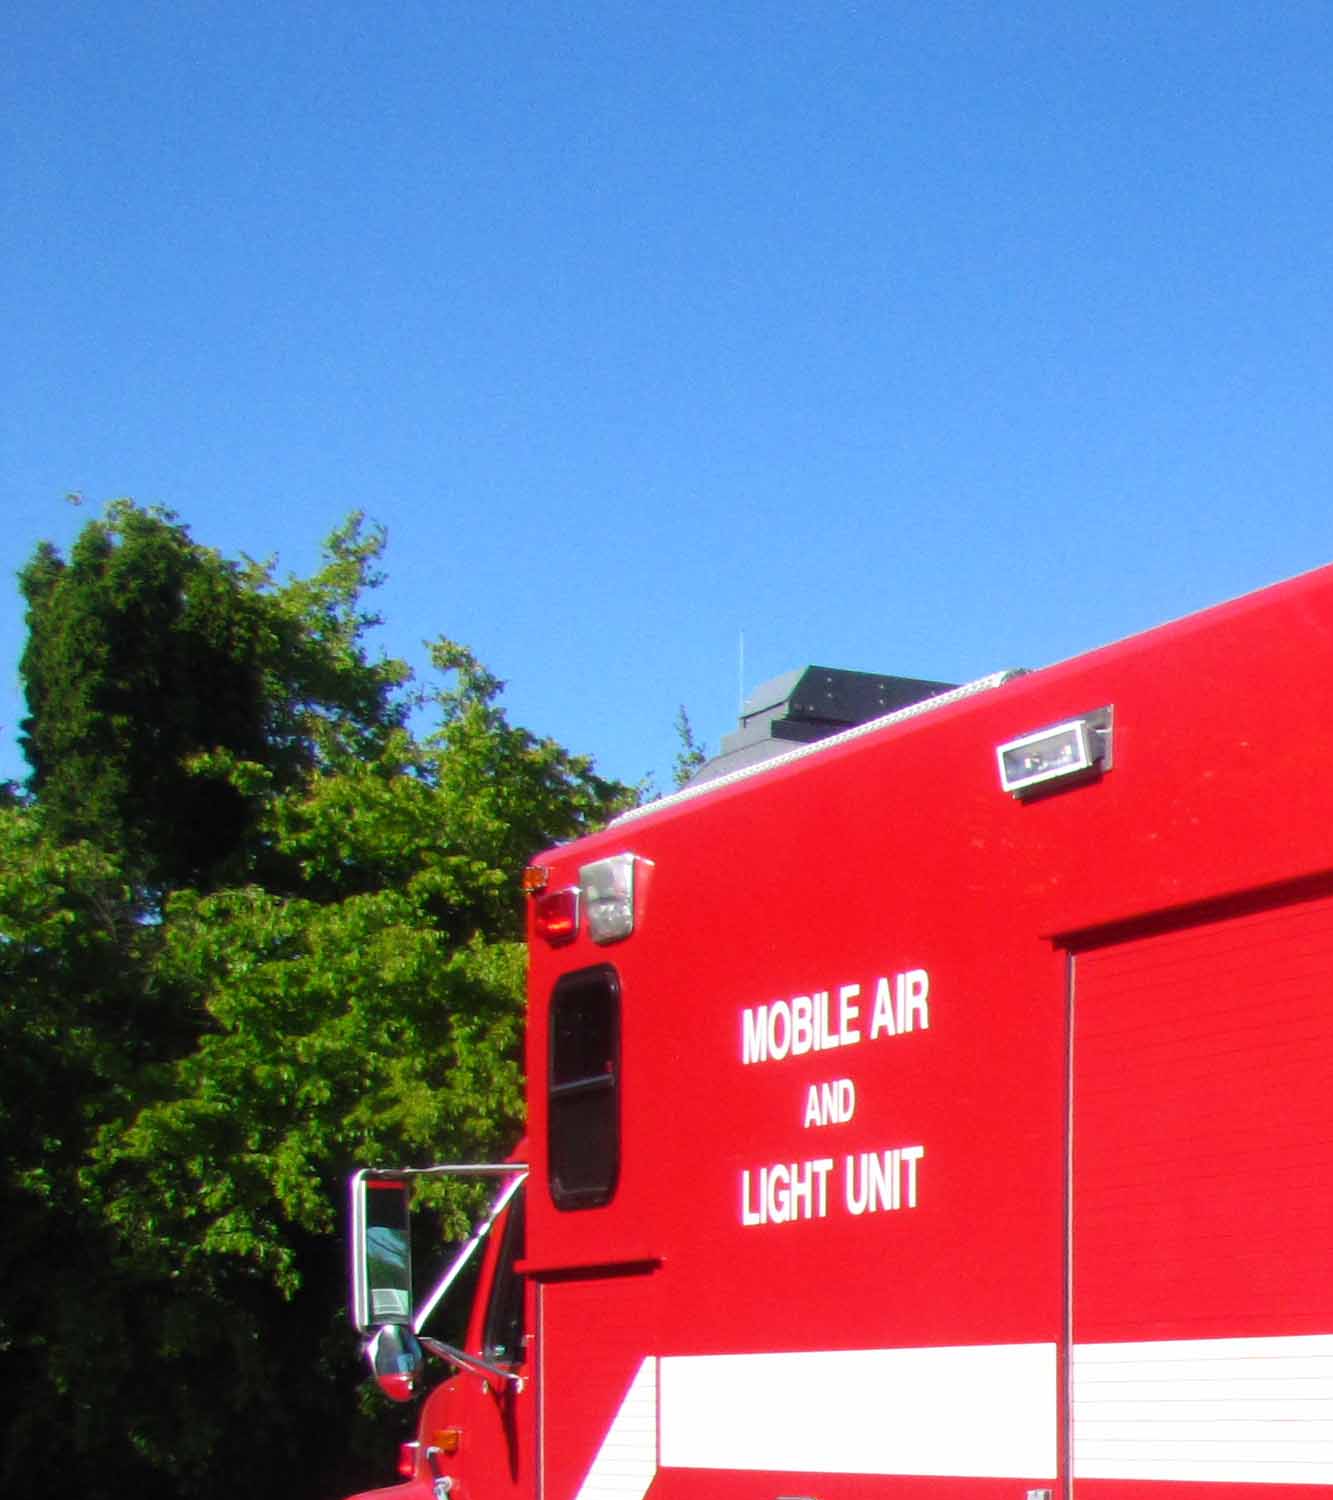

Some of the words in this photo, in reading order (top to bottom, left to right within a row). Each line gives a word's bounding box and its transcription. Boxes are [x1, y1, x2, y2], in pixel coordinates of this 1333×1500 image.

[742, 983, 861, 1065] MOBILE
[870, 968, 930, 1040] AIR
[804, 1078, 856, 1129] AND
[742, 1158, 834, 1226] LIGHT
[845, 1145, 925, 1216] UNIT
